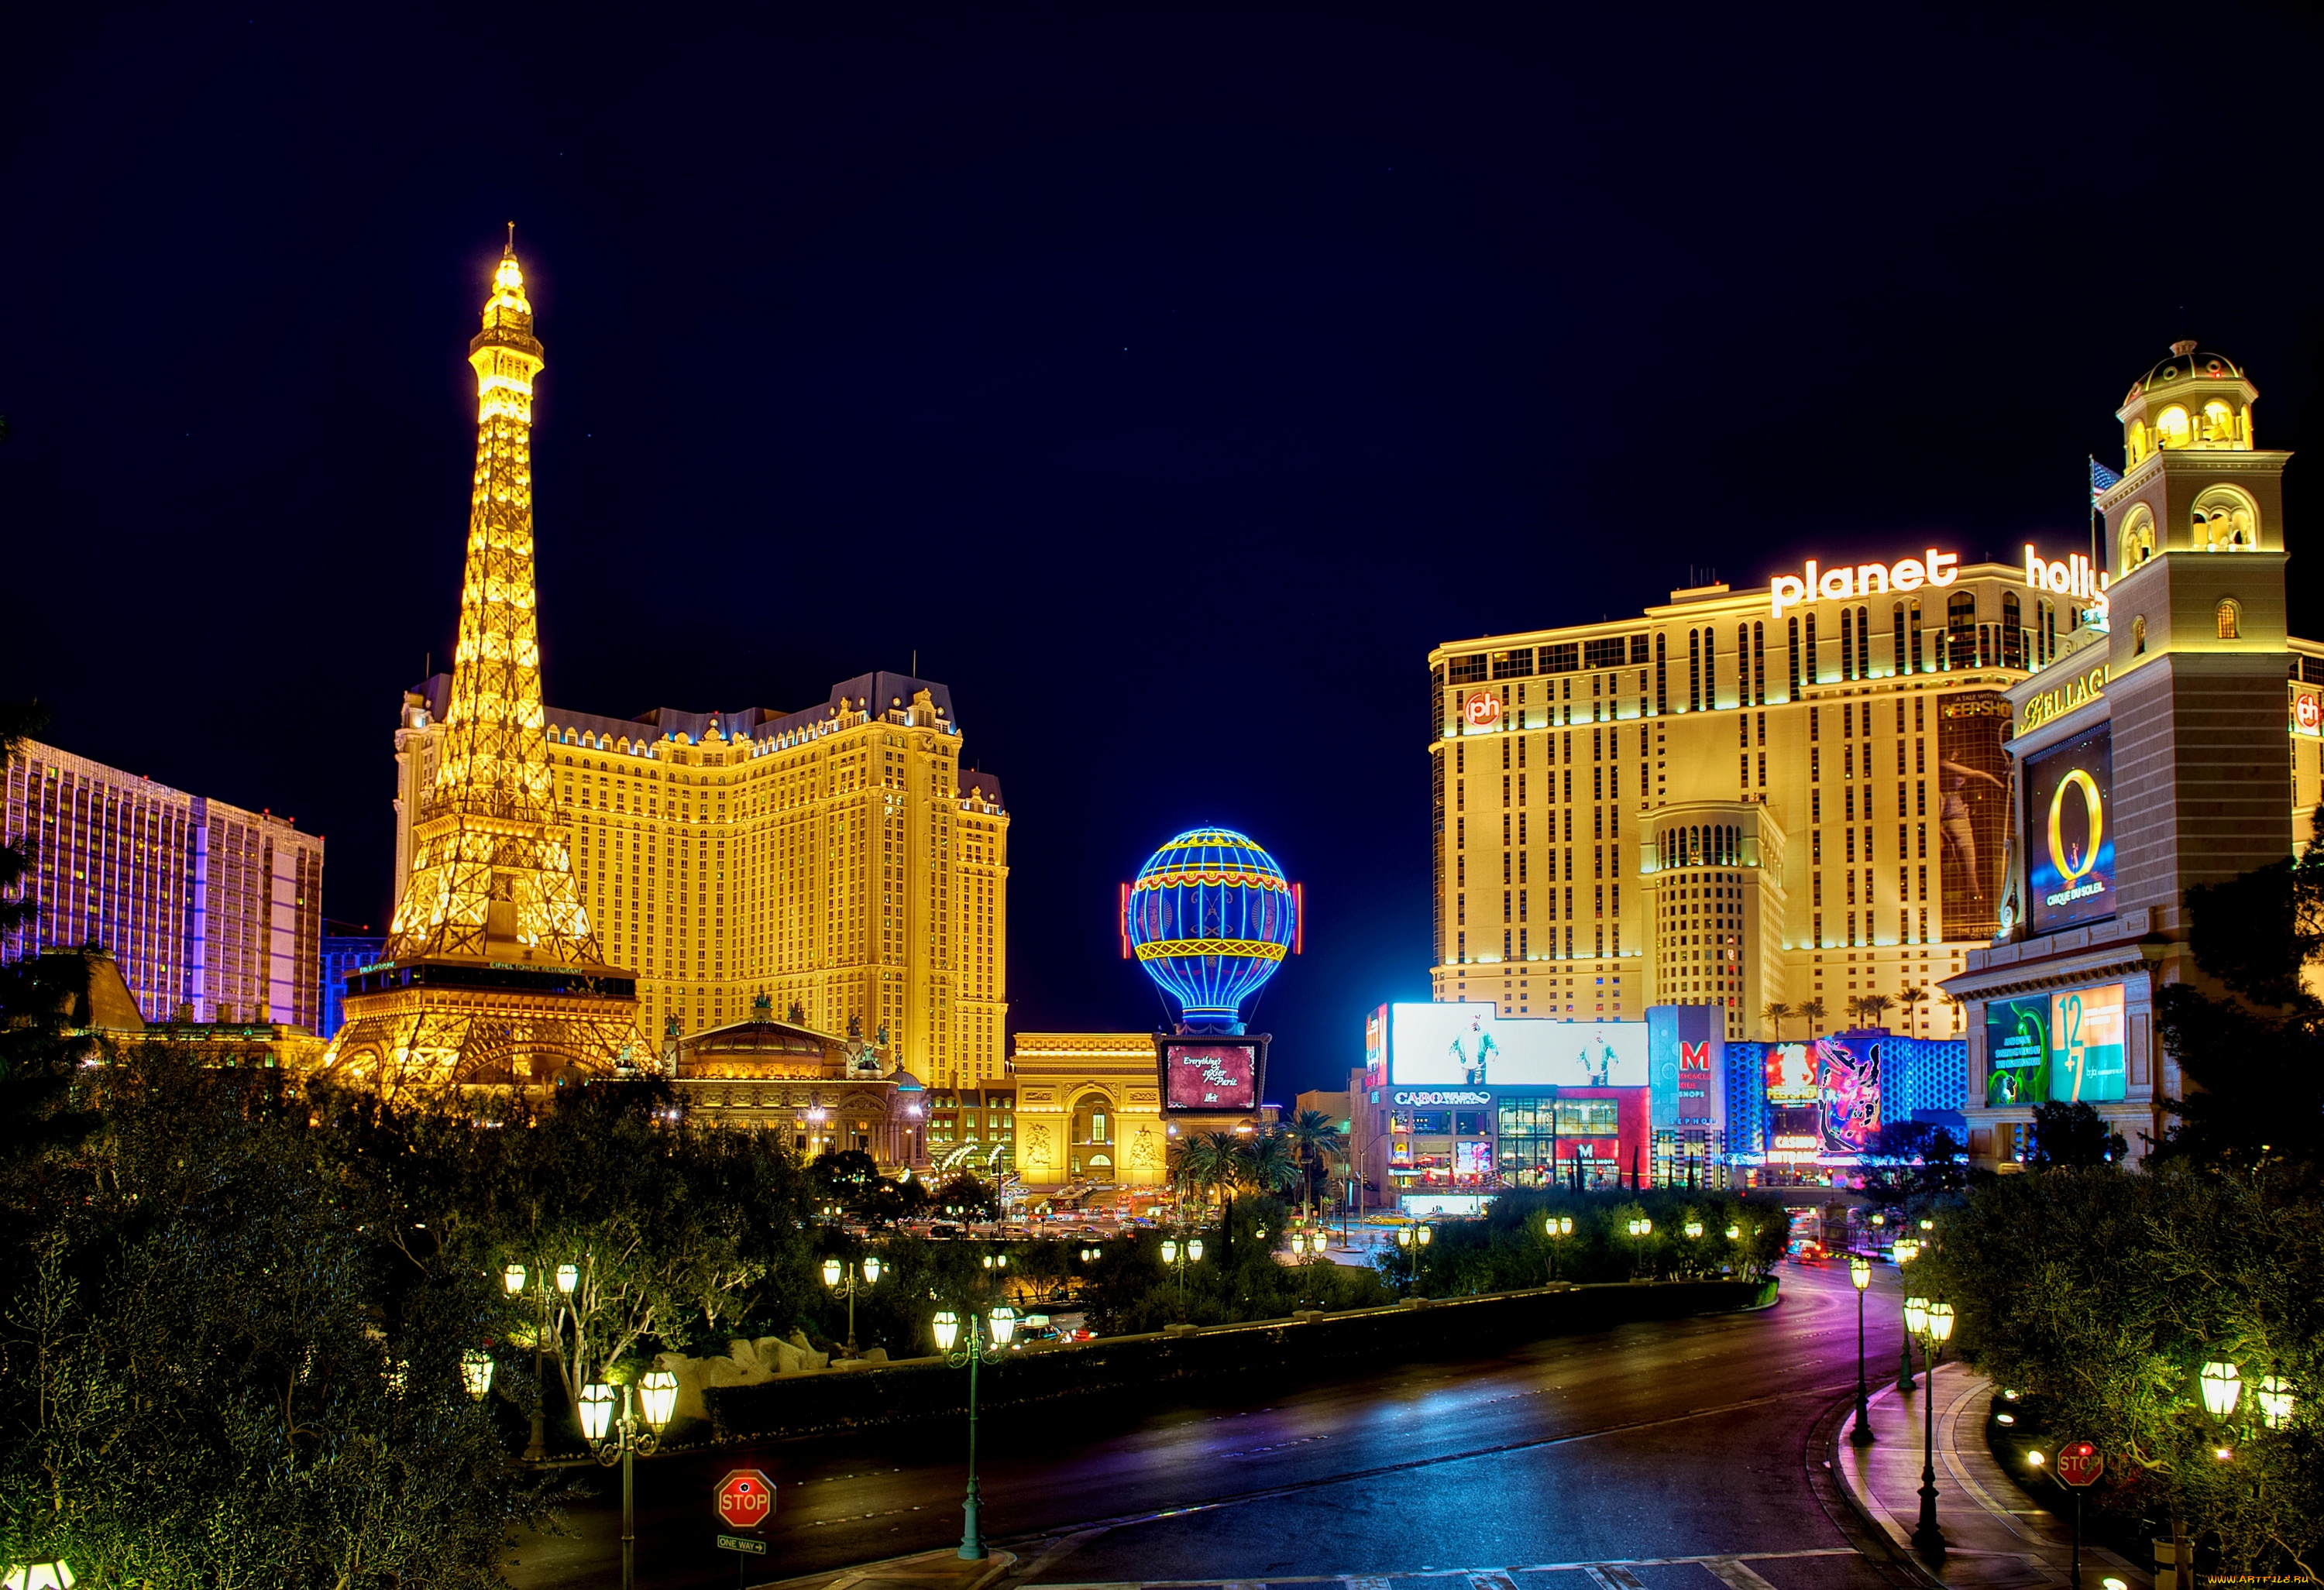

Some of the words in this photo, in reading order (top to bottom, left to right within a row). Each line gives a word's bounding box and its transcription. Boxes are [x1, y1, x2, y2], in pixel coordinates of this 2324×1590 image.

[1771, 548, 1959, 619] planet
[2024, 544, 2109, 609] holly
[2020, 663, 2110, 733] BELLAGI
[1469, 692, 1500, 723] ph
[2298, 695, 2319, 724] ph
[2047, 768, 2102, 881] O
[2047, 891, 2071, 906] CIRQUE
[2071, 888, 2081, 900] DU
[1679, 1041, 1710, 1070] M
[1394, 1092, 1442, 1108] CABO
[1578, 1143, 1593, 1158] M
[1776, 1136, 1817, 1149] CASINO
[1767, 1151, 1820, 1164] ENTRANC
[722, 1494, 768, 1510] STOP
[720, 1538, 737, 1547] ONE
[738, 1540, 755, 1551] WAY
